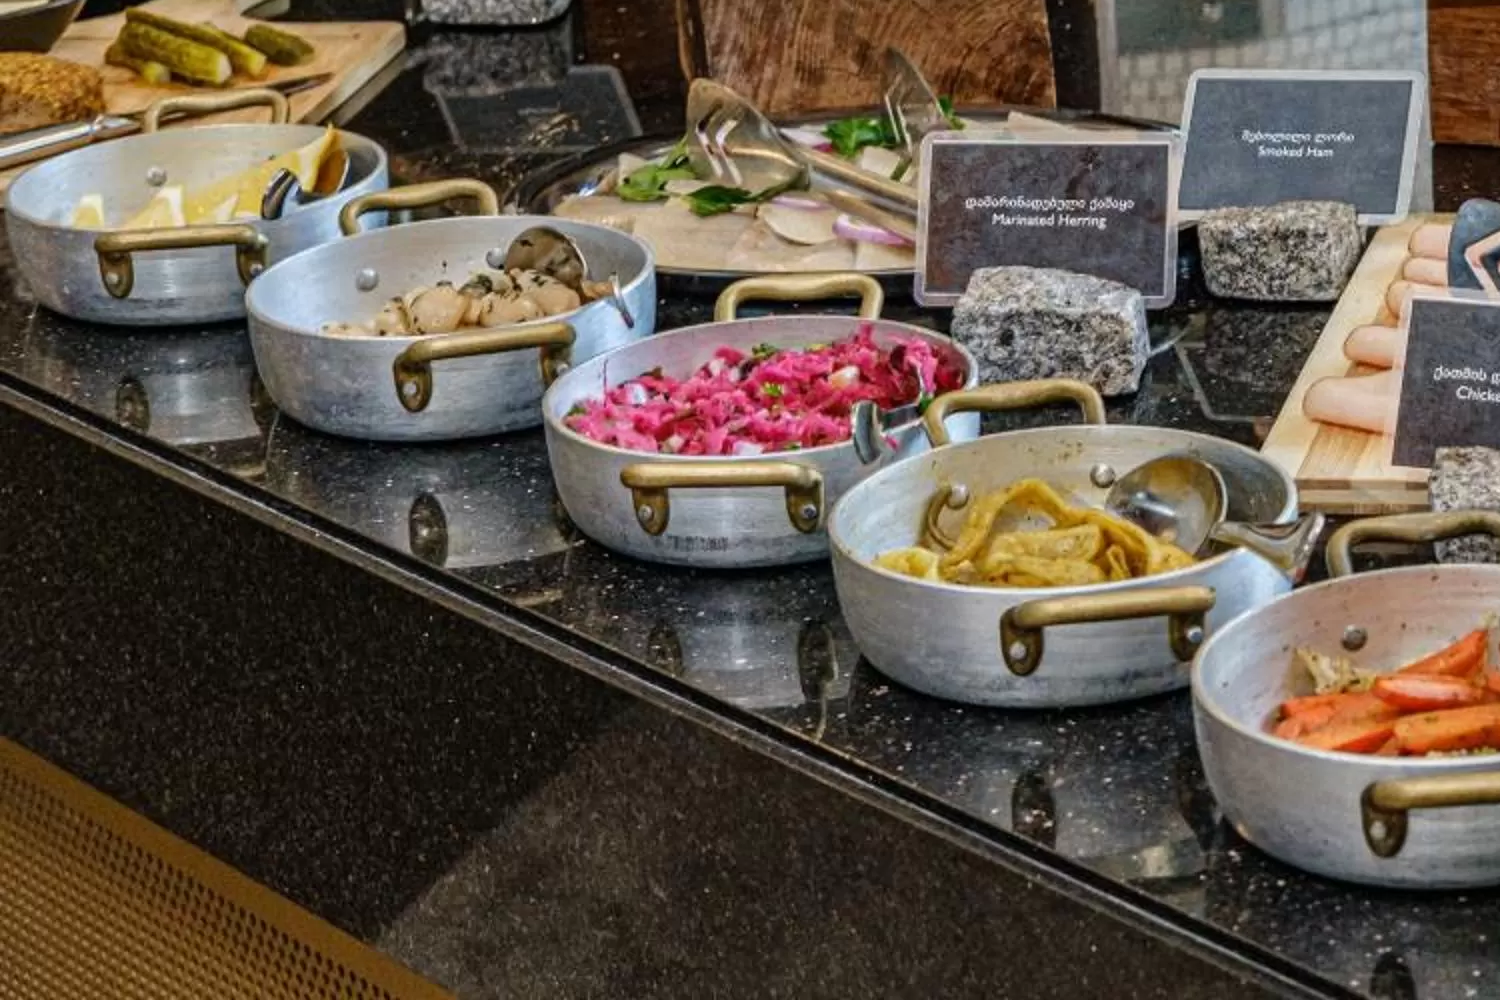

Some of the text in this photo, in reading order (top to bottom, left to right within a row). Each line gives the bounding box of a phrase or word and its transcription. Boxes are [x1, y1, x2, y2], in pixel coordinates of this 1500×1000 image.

[1258, 145, 1334, 157] Smoked Ham
[991, 213, 1107, 231] Marinated Herring
